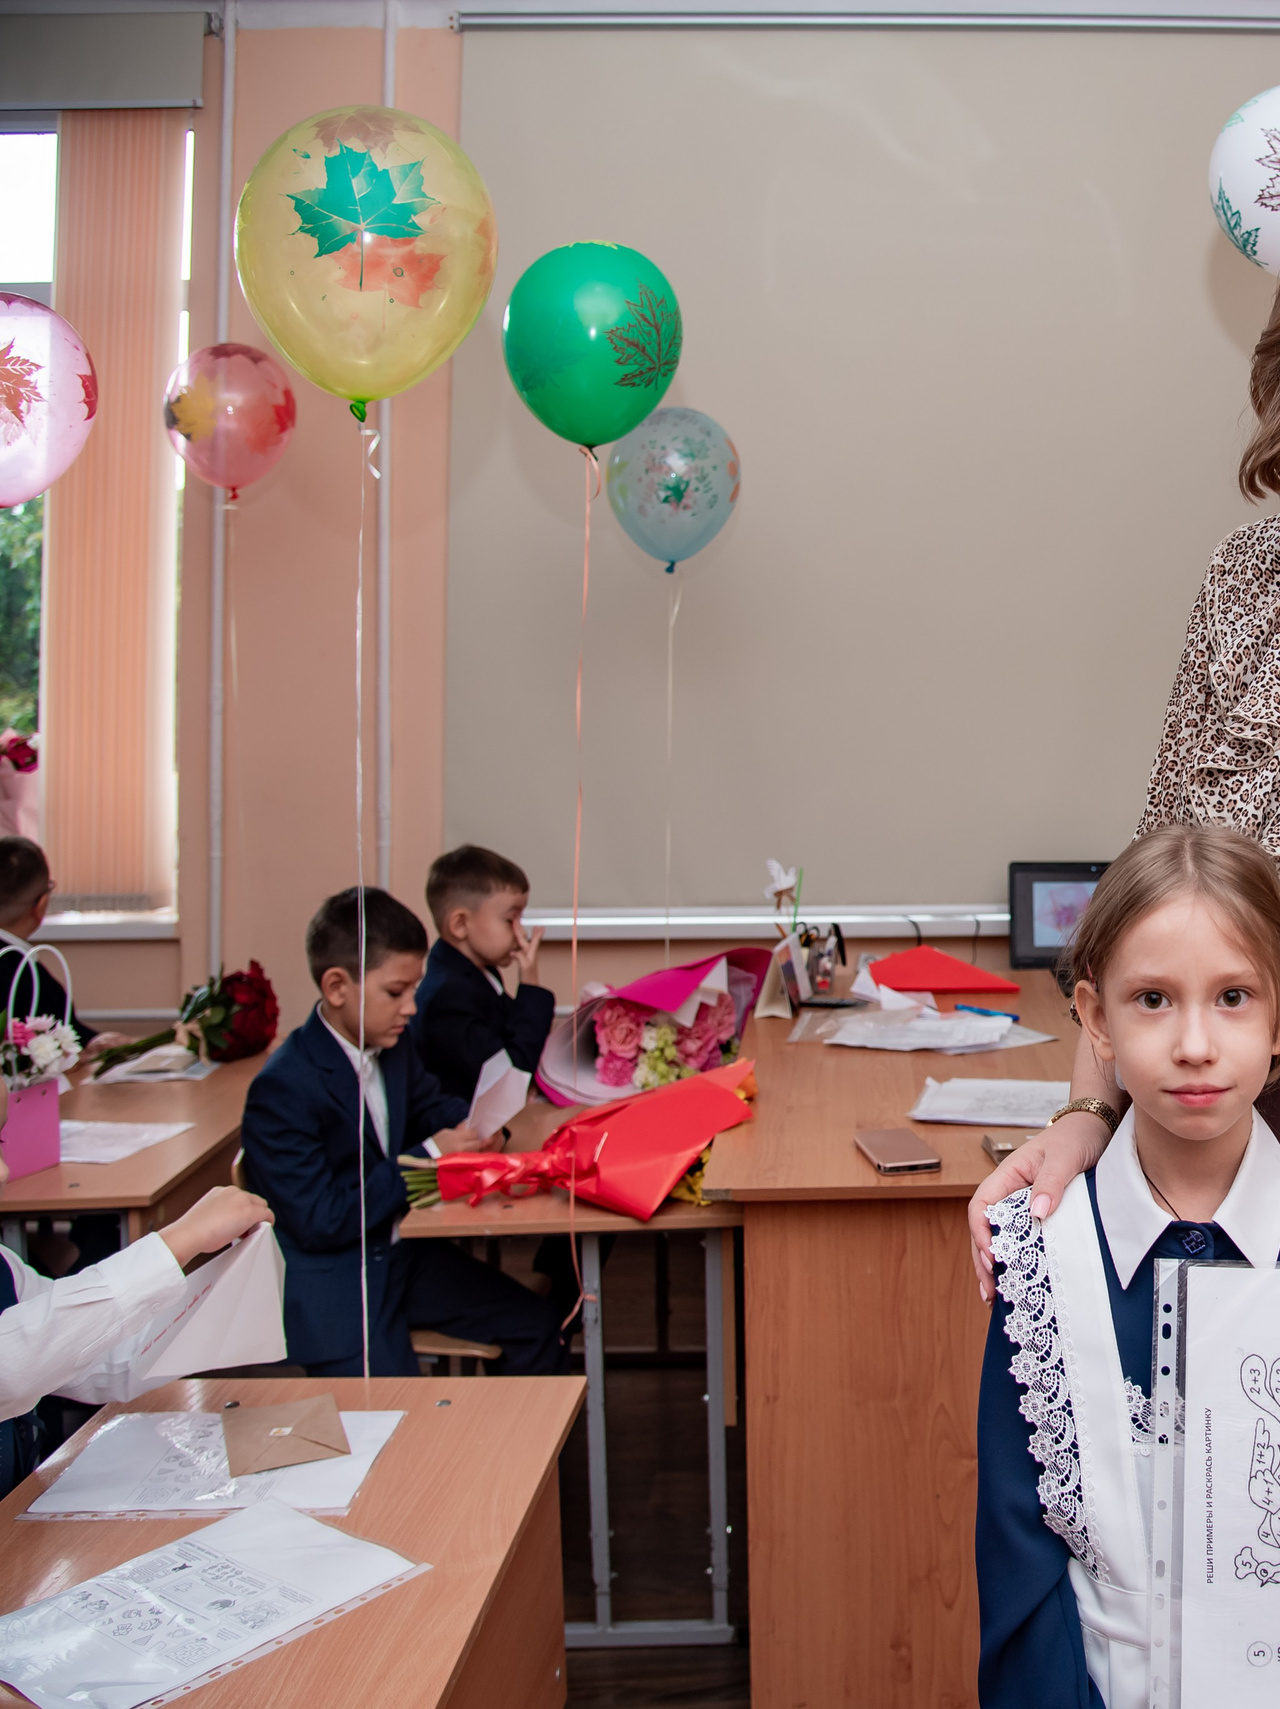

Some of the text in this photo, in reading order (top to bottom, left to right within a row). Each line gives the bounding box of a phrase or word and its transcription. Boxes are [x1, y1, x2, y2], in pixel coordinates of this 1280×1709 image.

[1250, 1368, 1261, 1394] 2+3
[1257, 1442, 1266, 1464] 1+2
[1262, 1478, 1274, 1505] 4+1
[1241, 1560, 1252, 1568] 5
